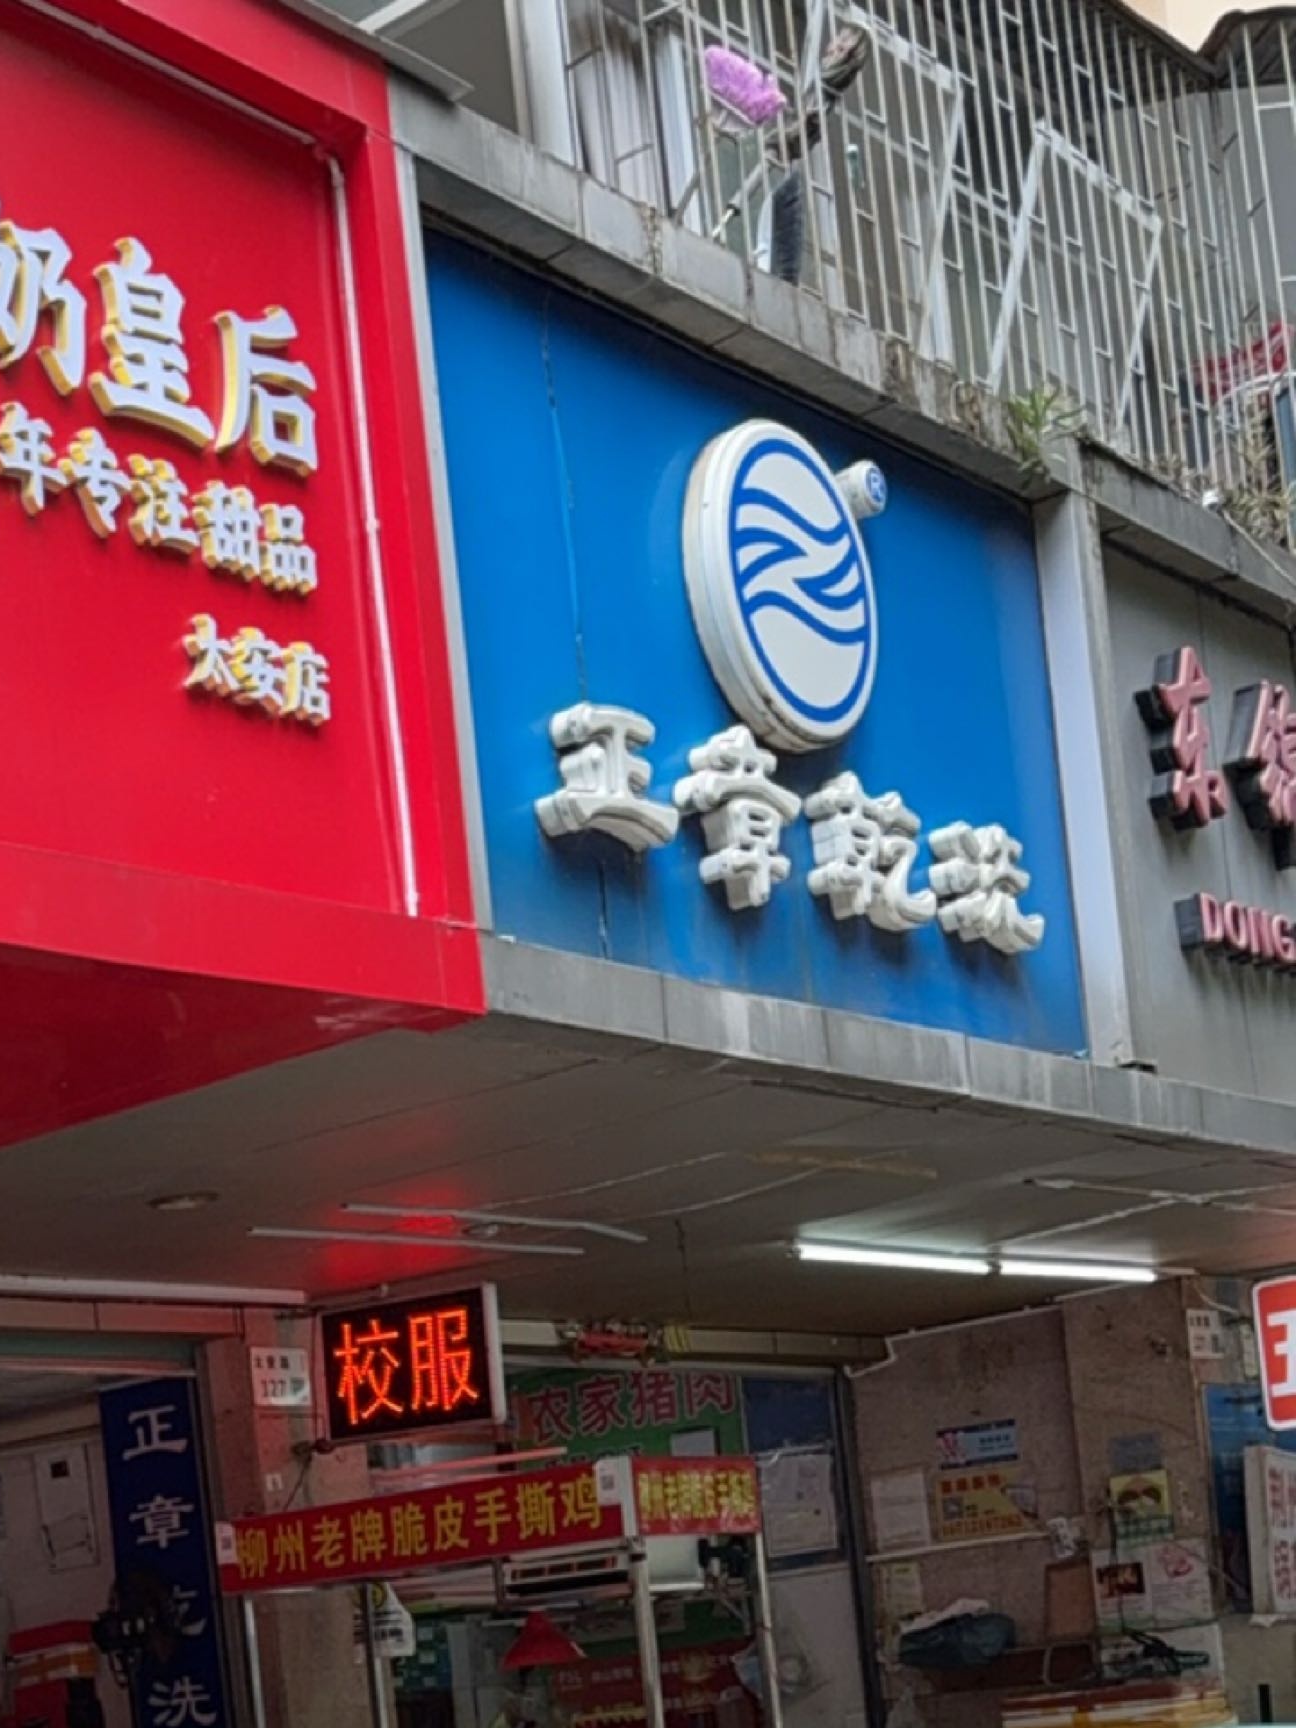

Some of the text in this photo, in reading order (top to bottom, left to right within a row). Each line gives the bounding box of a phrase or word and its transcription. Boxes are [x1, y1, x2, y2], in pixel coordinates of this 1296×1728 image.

[182, 613, 330, 727] 太安店
[334, 1305, 479, 1425] 校服
[525, 1364, 737, 1441] 农家猪肉
[121, 1404, 218, 1728] 正章洗
[236, 1473, 603, 1579] 柳州老牌脆皮手撕鸡
